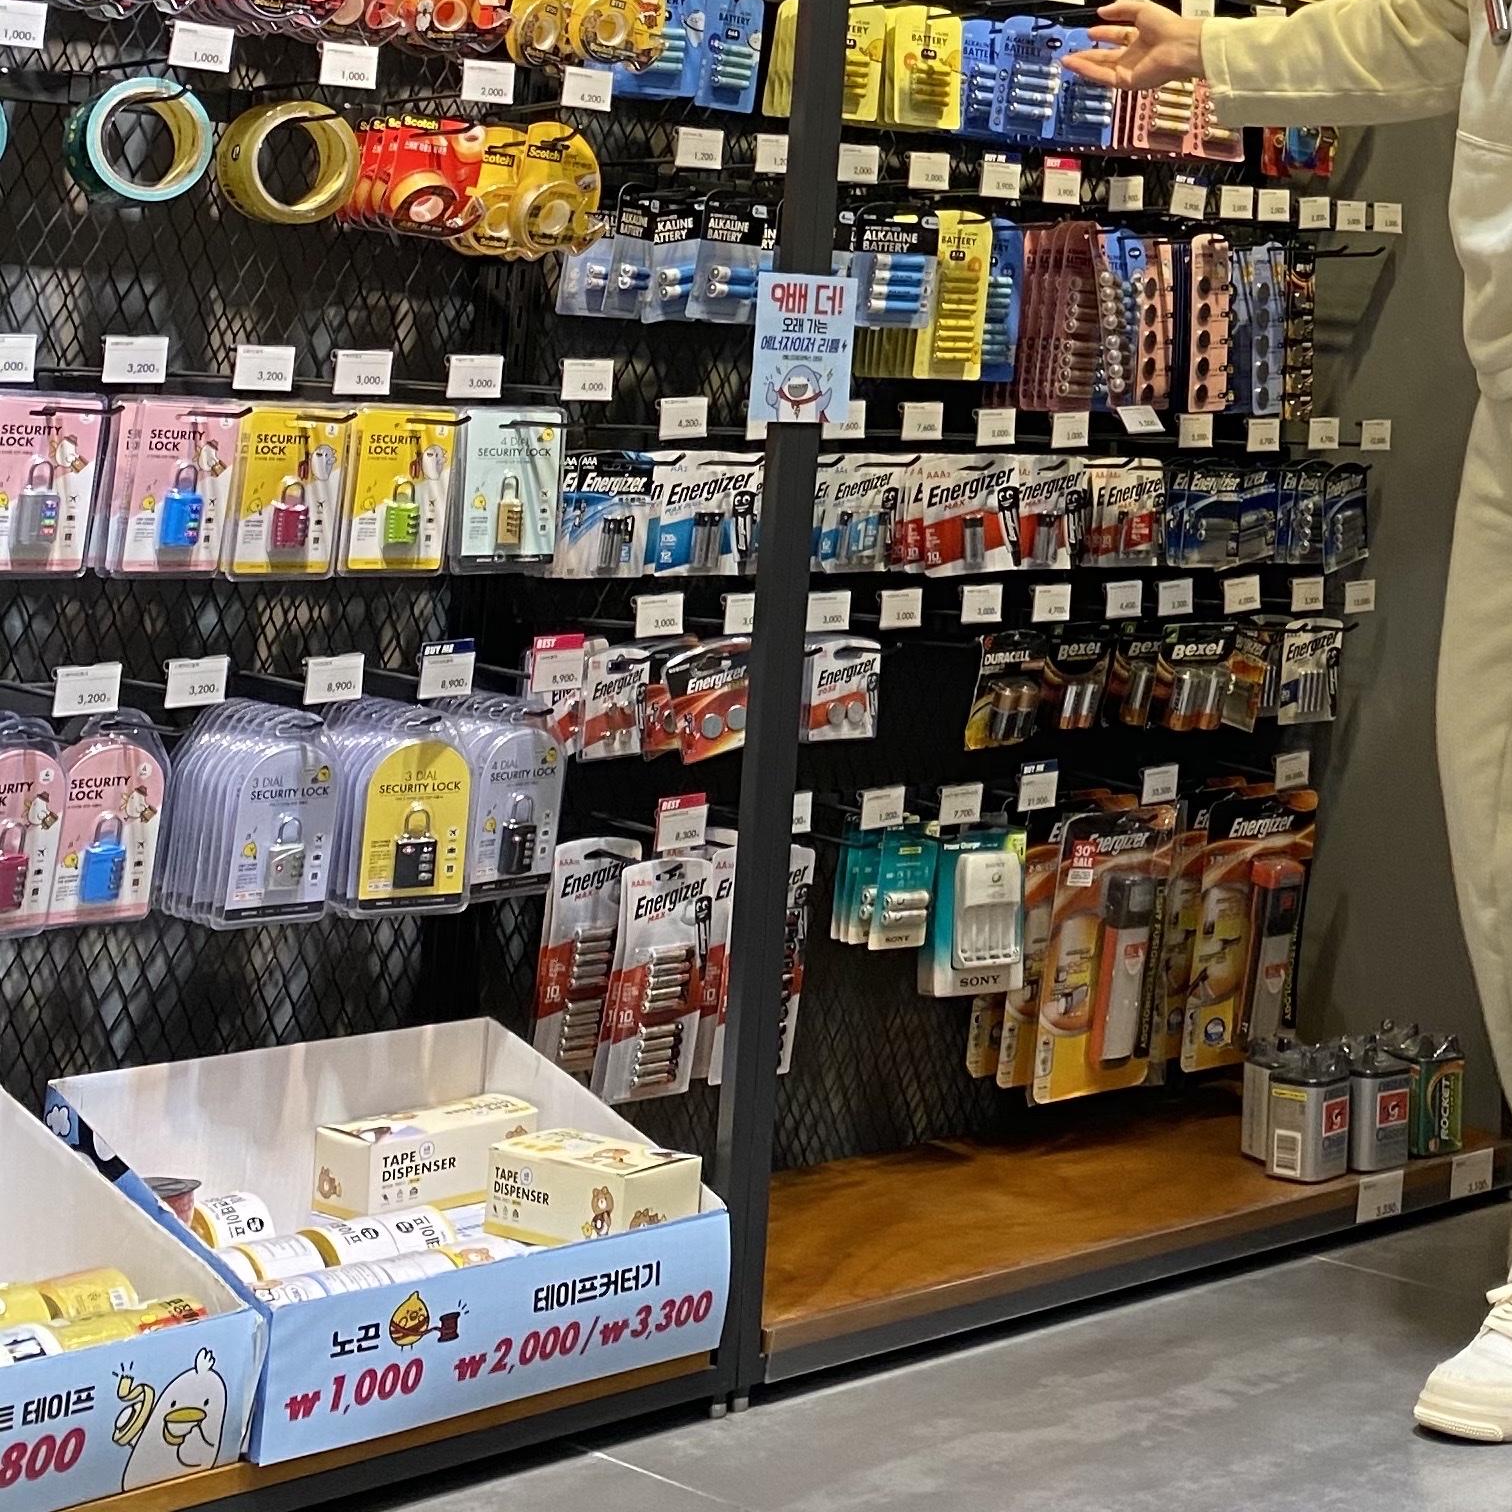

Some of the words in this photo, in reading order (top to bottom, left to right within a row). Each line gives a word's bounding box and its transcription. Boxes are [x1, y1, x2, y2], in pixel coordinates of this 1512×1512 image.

[912, 33, 948, 48] BATTERY
[341, 70, 365, 82] 1,000
[481, 87, 504, 98] 2,000
[708, 217, 750, 234] ALKALINE
[707, 228, 743, 243] BATTERY
[864, 232, 918, 243] ALKALINE
[863, 241, 909, 252] BATTERY
[771, 283, 808, 314] 9배
[815, 283, 844, 315] 더!
[782, 317, 803, 334] 오래
[805, 319, 827, 334] 가는
[761, 336, 815, 353] 에너자이저
[818, 337, 840, 353] 리튬
[127, 363, 155, 374] 3,200
[257, 371, 284, 382] 3,200
[356, 375, 381, 386] 3,000
[1, 424, 62, 436] SECURITY
[150, 429, 205, 441] SECURITY
[0, 436, 34, 447] LOCK
[149, 440, 180, 452] LOCK
[370, 435, 421, 445] SECURITY
[368, 445, 398, 456] LOCK
[477, 447, 524, 457] SECURITY
[525, 447, 551, 457] LOCK
[583, 472, 646, 492] Energizer
[667, 472, 754, 505] Energizer
[835, 472, 893, 500] Energizer
[928, 466, 1015, 507] Energizer
[984, 649, 1030, 665] DURACELL
[1172, 642, 1224, 660] Bexel
[818, 658, 876, 687] Energizer
[327, 681, 352, 691] 8,900
[70, 775, 131, 789] SECURITY
[416, 770, 437, 781] DIAL
[69, 789, 104, 801] LOCK
[379, 783, 430, 794] SECURITY
[432, 781, 461, 792] LOCK
[661, 799, 681, 810] BEST
[1229, 813, 1293, 839] Energizer
[1072, 857, 1094, 869] SALE
[634, 875, 707, 921] Energizer
[959, 972, 1001, 988] SONY
[1440, 1078, 1451, 1140] ROCKET
[382, 1151, 417, 1168] TAPE
[381, 1156, 457, 1182] DISPENSER
[494, 1167, 519, 1184] TAPE
[493, 1180, 550, 1206] DISPENSER
[533, 1260, 661, 1313] 테이프커터기
[329, 1322, 380, 1359] 노끈
[22, 1385, 96, 1426] 테이프
